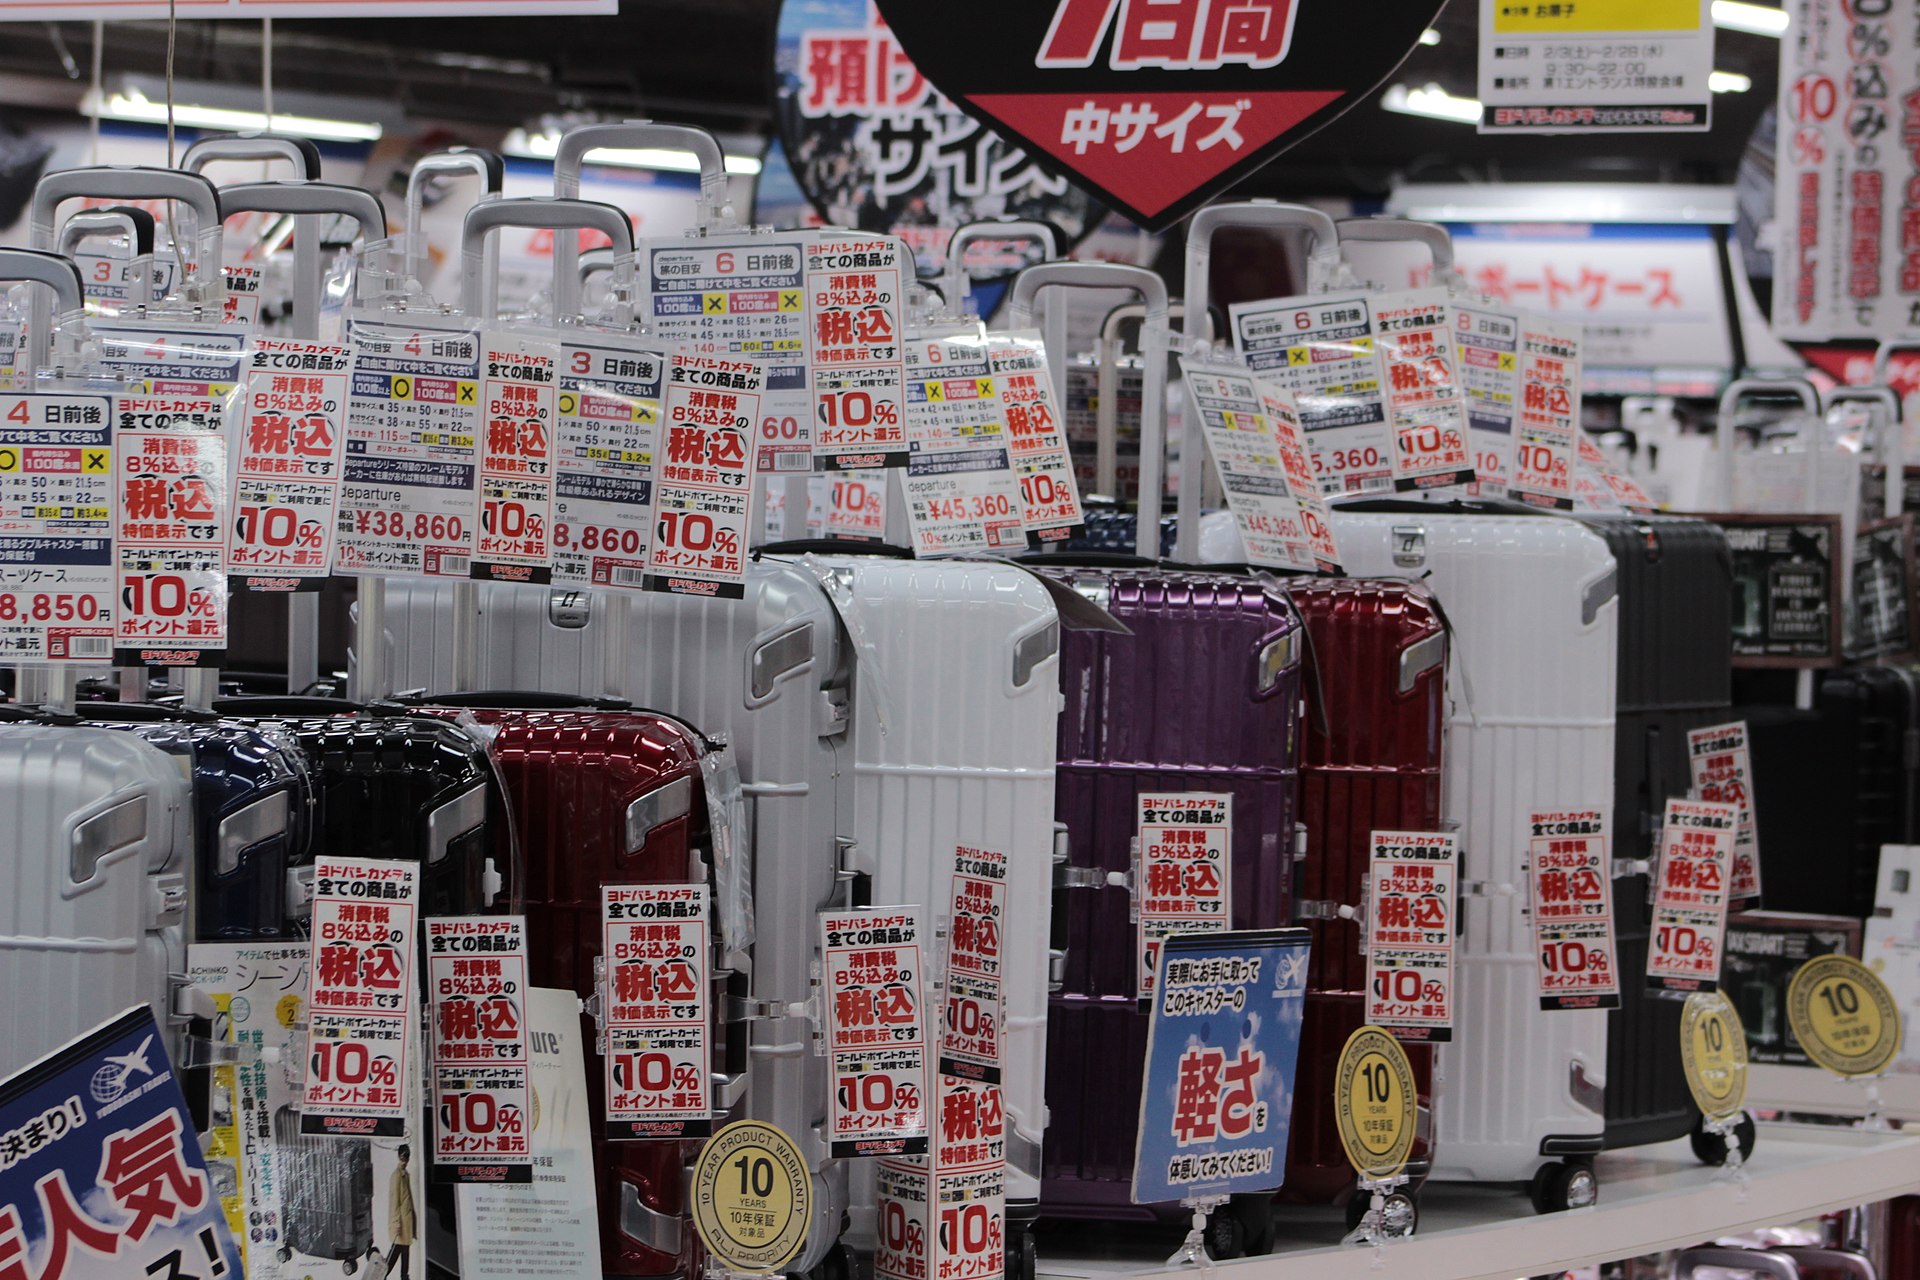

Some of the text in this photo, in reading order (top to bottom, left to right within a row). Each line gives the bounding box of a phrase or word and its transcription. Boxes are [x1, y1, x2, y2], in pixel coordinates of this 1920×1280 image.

[1061, 99, 1251, 154] 中サイズ
[807, 241, 894, 254] ヨドバシカメラは
[94, 262, 111, 281] 3
[660, 252, 794, 275] 旅の目安 6 日前後
[829, 274, 876, 289] 消費税
[700, 318, 713, 328] 42
[774, 315, 787, 325] 26
[816, 309, 893, 346] 税込
[1294, 308, 1362, 330] 6 日前後
[1457, 313, 1472, 332] 8
[404, 333, 473, 359] 4 日前後
[700, 331, 714, 340] 45
[694, 343, 715, 353] 140
[927, 343, 942, 364] 6
[252, 351, 347, 370] 全ての商品が
[488, 351, 553, 367] ヨドバシカメラは
[571, 351, 654, 379] 3 日前後
[671, 354, 761, 374] ヨドバシカメラは
[487, 362, 553, 382] 全ての商品が
[670, 366, 759, 389] 全ての商品が
[7, 400, 101, 425] 4 日前後
[118, 399, 221, 413] ヨドバシカメラは
[387, 402, 399, 413] 35
[420, 405, 432, 416] 50
[819, 391, 897, 427] 10%
[119, 411, 221, 430] 全ての商品が
[386, 416, 399, 427] 38
[418, 419, 431, 430] 55
[451, 422, 463, 432] 22
[586, 421, 600, 432] 50
[672, 406, 748, 428] 8%込みの
[248, 415, 332, 456] 税込
[380, 430, 398, 441] 115
[488, 419, 546, 458] 税込
[585, 434, 638, 449] 55 22
[667, 427, 744, 468] 税込
[31, 477, 47, 488] 50
[240, 480, 331, 494] ゴールドポイントカード
[908, 480, 957, 492] departure
[31, 492, 92, 504] 55 22
[341, 486, 401, 502] departure
[660, 488, 743, 503] ゴールドポイントカード
[833, 482, 881, 517] 10%
[122, 522, 218, 539] 特価表示です
[239, 506, 322, 548] 10%
[484, 500, 543, 540] 10%
[660, 511, 737, 554] 10%
[122, 549, 218, 559] ゴールドポイントカード
[124, 575, 215, 616] 10%
[1143, 808, 1224, 824] 全ての商品が
[1162, 829, 1206, 844] 消費税
[1532, 821, 1601, 836] 全ての商品が
[1375, 844, 1451, 860] 全ての商品が
[317, 864, 412, 881] ヨドバシカメラは
[954, 856, 1006, 878] 全ての商品が
[317, 878, 411, 899] 全ての商品が
[1147, 863, 1219, 897] 税込
[1379, 878, 1445, 895] 8%込みの
[1539, 870, 1601, 902] 税込
[607, 889, 700, 901] ヨドバシカメラは
[608, 901, 701, 918] 全ての商品が
[1378, 896, 1445, 928] 税込
[430, 922, 519, 934] ヨドバシカメラは
[630, 925, 680, 942] 消費税
[826, 916, 914, 931] ヨドバシカメラは
[431, 934, 520, 952] 全ての商品が
[953, 915, 997, 956] 税込
[614, 941, 695, 958] 8%込みの
[318, 945, 400, 989] 税込
[1167, 961, 1260, 985] 実際にお手に取って
[614, 963, 696, 1002] 税込
[1375, 969, 1444, 1004] 10%
[836, 987, 915, 1028] 税込
[1164, 989, 1244, 1014] このキャスターの
[1819, 982, 1859, 1017] 10
[440, 1000, 519, 1040] 税込
[612, 1004, 699, 1019] 特価表示です
[948, 996, 995, 1040] 10%
[612, 1028, 700, 1038] ゴールドポイントカード
[1701, 1017, 1722, 1053] 10
[314, 1042, 395, 1086] 10%
[614, 1052, 698, 1091] 10%
[839, 1074, 918, 1112] 10%
[1362, 1062, 1391, 1103] 10
[442, 1092, 522, 1134] 10%
[942, 1087, 1003, 1143] 税込
[702, 1131, 804, 1216] 10 YEAR PRODUCT WARRANTY
[734, 1156, 774, 1197] 10
[739, 1198, 767, 1209] YEARS
[730, 1212, 775, 1227] 10年保証
[940, 1203, 1001, 1256] 10%
[739, 1227, 765, 1239] 対象品
[737, 1234, 790, 1263] PRIORITY
